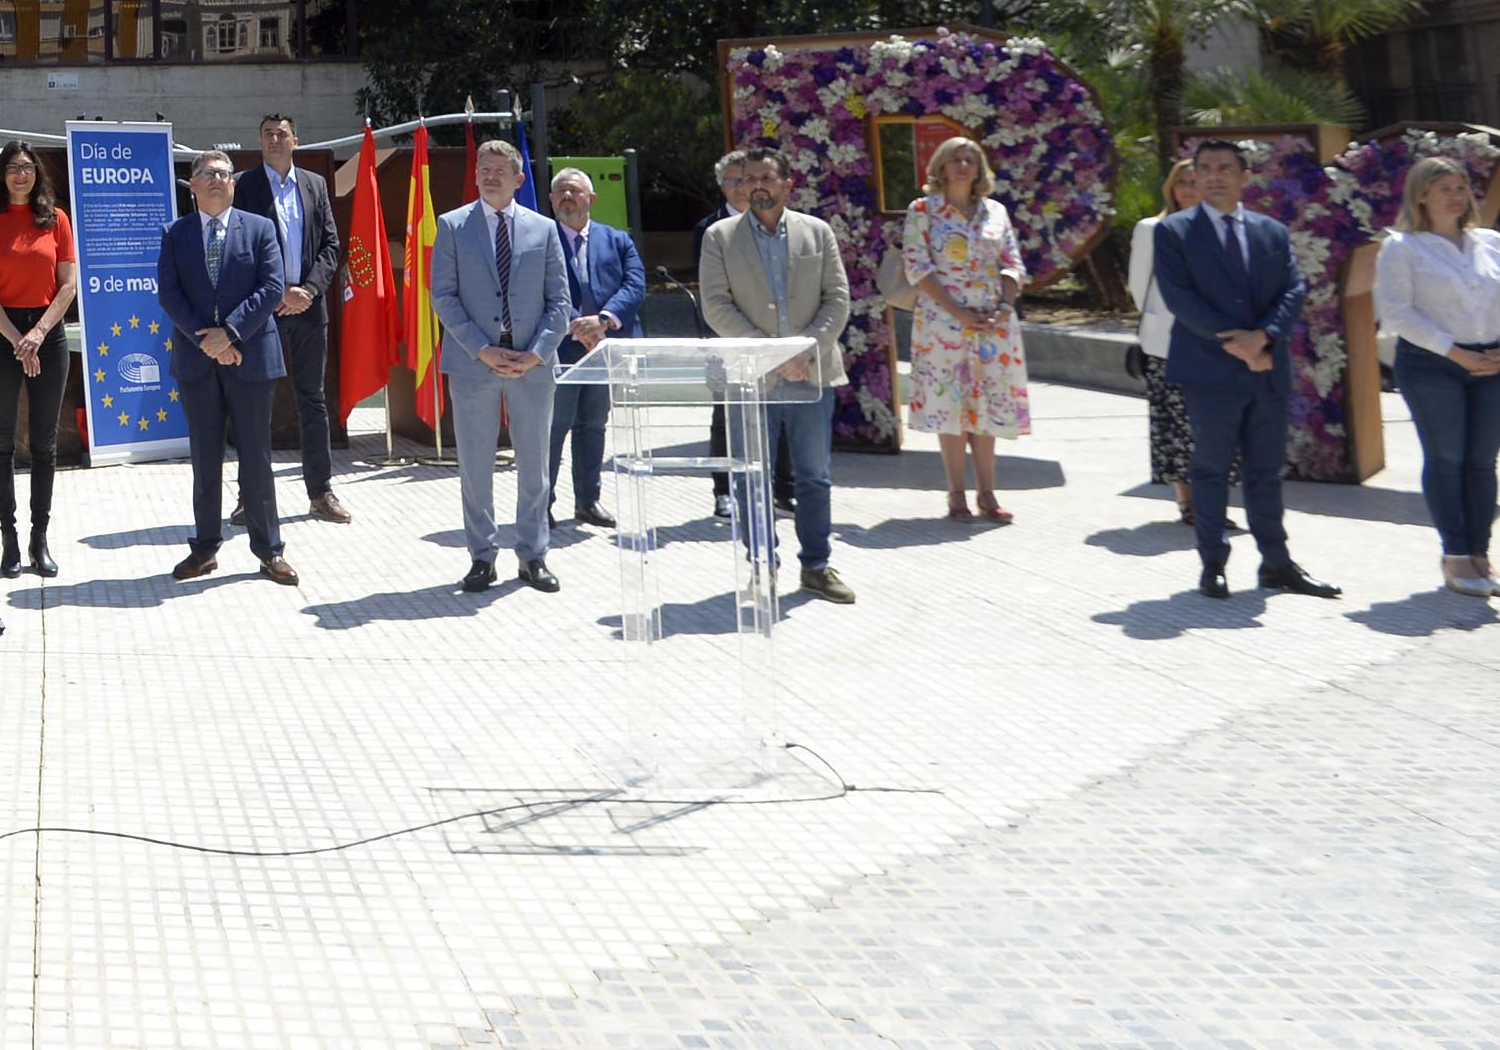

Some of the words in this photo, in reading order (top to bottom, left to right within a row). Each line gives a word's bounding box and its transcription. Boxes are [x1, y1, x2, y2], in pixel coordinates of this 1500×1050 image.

[81, 142, 107, 160] Día
[111, 143, 132, 160] de
[82, 167, 154, 184] EUROPA
[89, 276, 100, 293] 9
[104, 275, 124, 292] de
[127, 277, 159, 294] may
